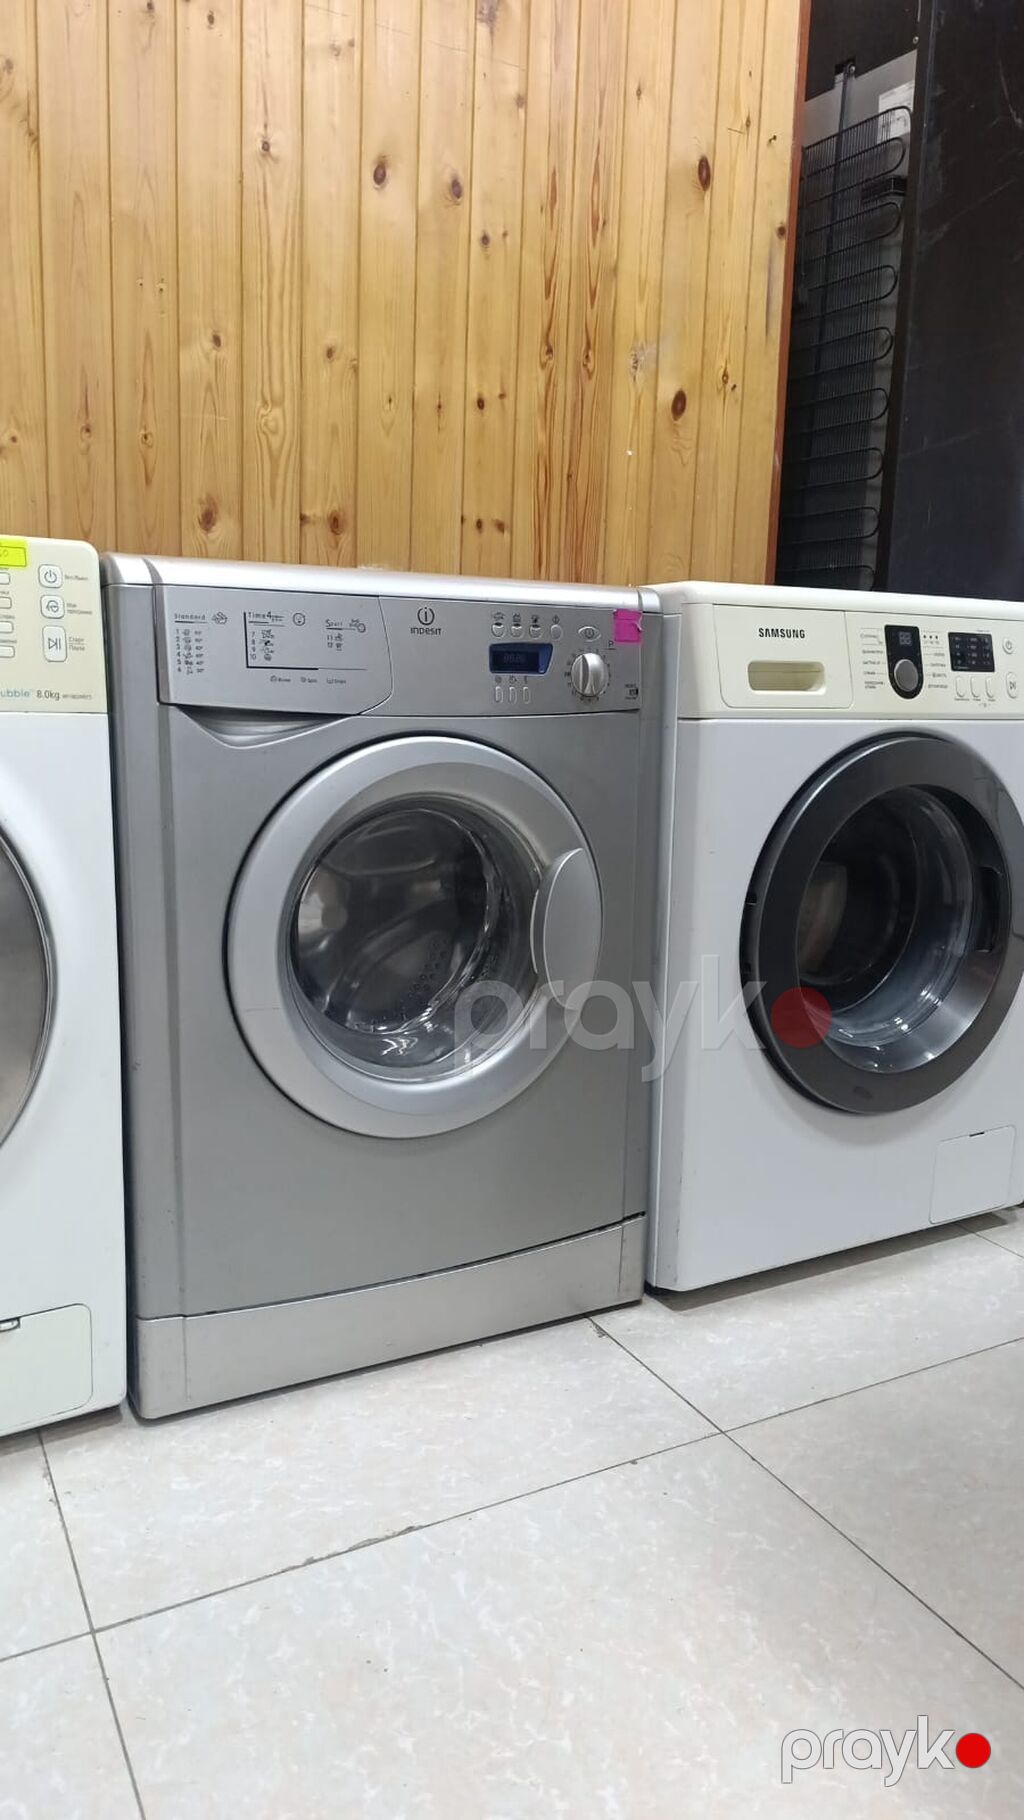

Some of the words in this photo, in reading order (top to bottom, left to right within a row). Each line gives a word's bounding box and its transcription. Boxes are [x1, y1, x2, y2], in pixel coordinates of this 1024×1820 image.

[410, 627, 442, 636] INDESIT
[758, 627, 806, 639] SAMSUNG
[36, 689, 60, 701] 8.0kg
